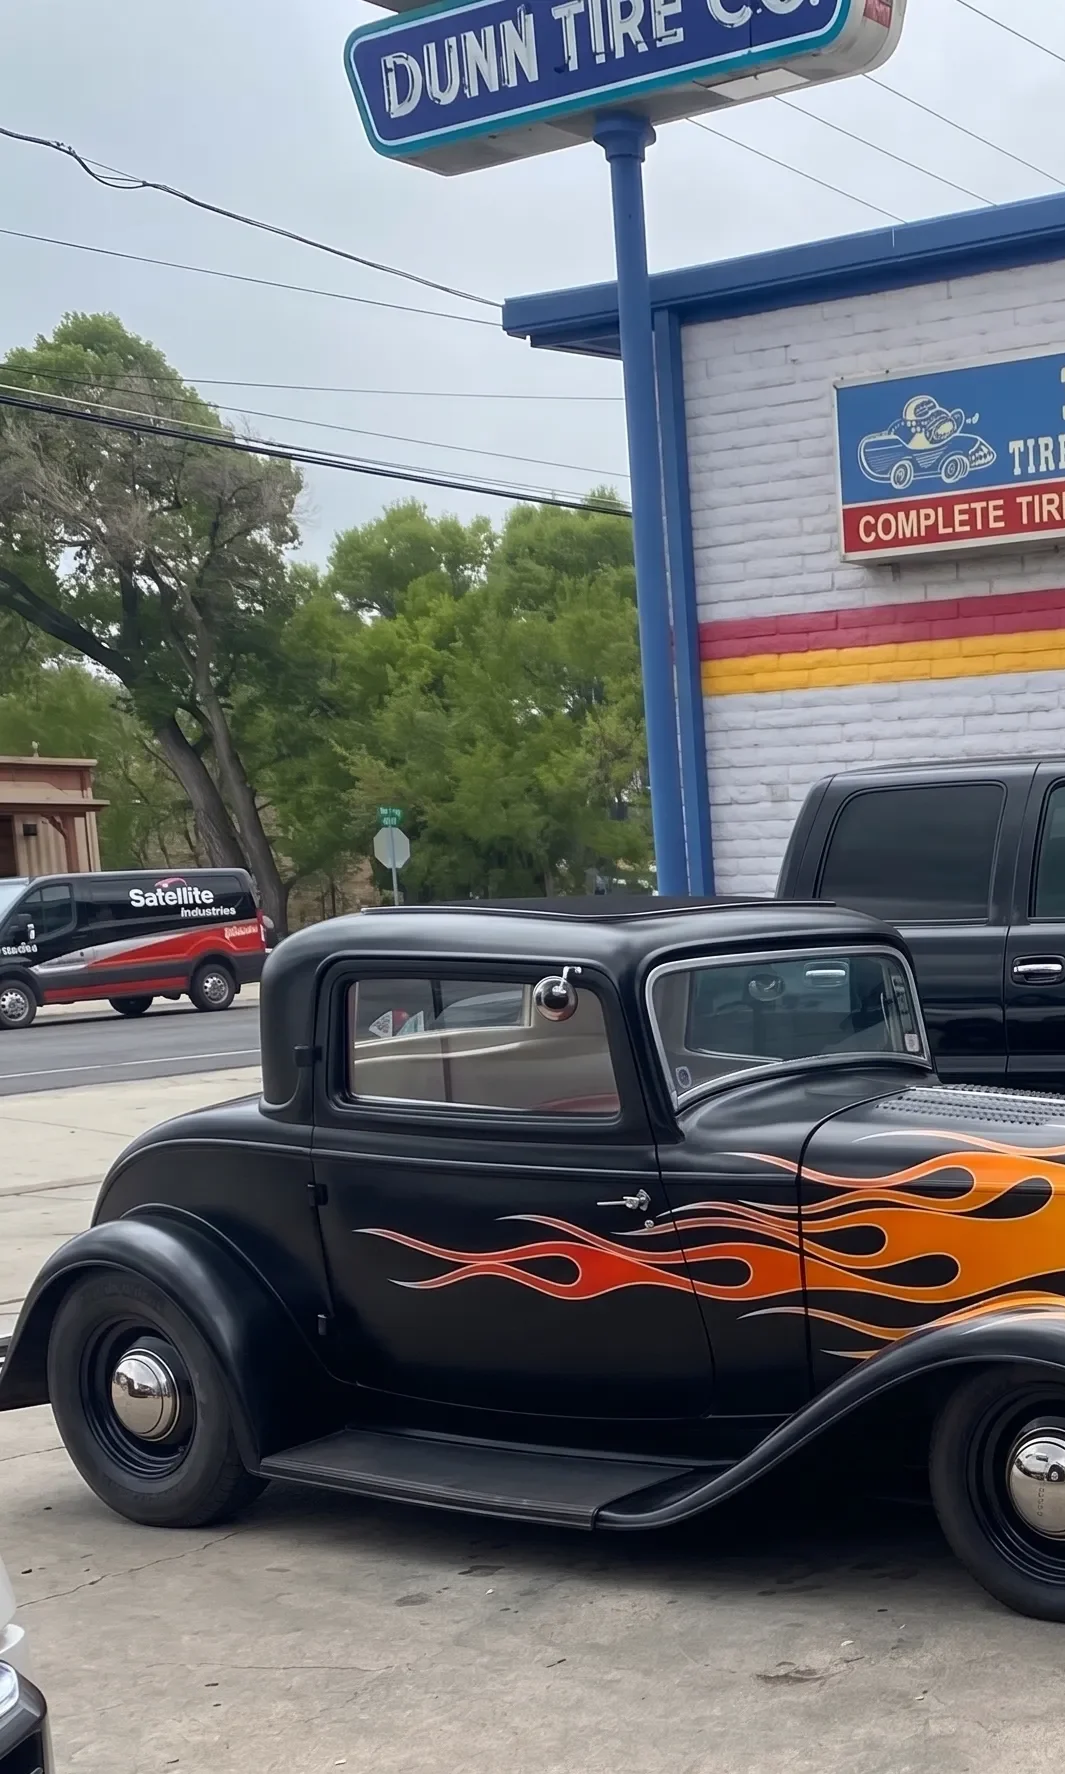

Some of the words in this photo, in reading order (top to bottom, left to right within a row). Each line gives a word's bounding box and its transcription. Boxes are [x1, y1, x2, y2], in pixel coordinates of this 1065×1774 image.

[382, 5, 539, 118] DUNN
[552, 0, 684, 71] TIRE
[859, 501, 1005, 543] COMPLETE
[129, 886, 214, 908] Satellite
